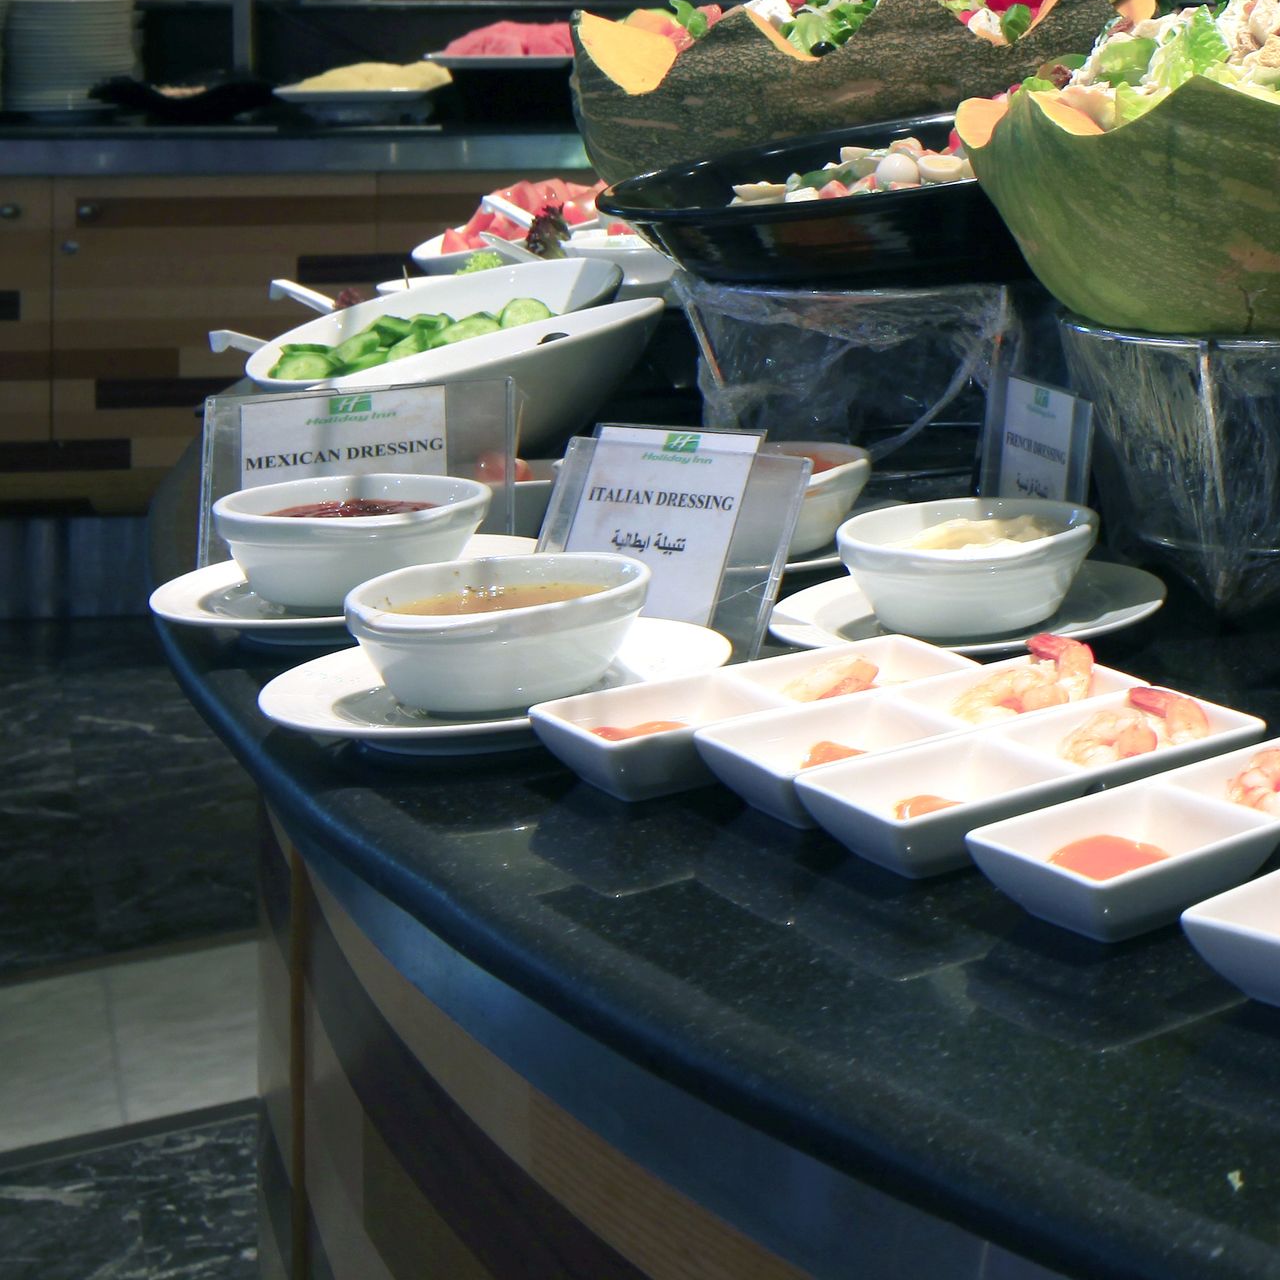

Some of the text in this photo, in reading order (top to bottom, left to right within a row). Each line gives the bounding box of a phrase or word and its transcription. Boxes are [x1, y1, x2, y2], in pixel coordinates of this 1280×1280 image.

[305, 410, 398, 426] Holiday Inn
[245, 437, 444, 471] MEXICAN DRESSING
[641, 451, 713, 465] Holiday Inn
[588, 486, 735, 511] ITALIAN DRESSING
